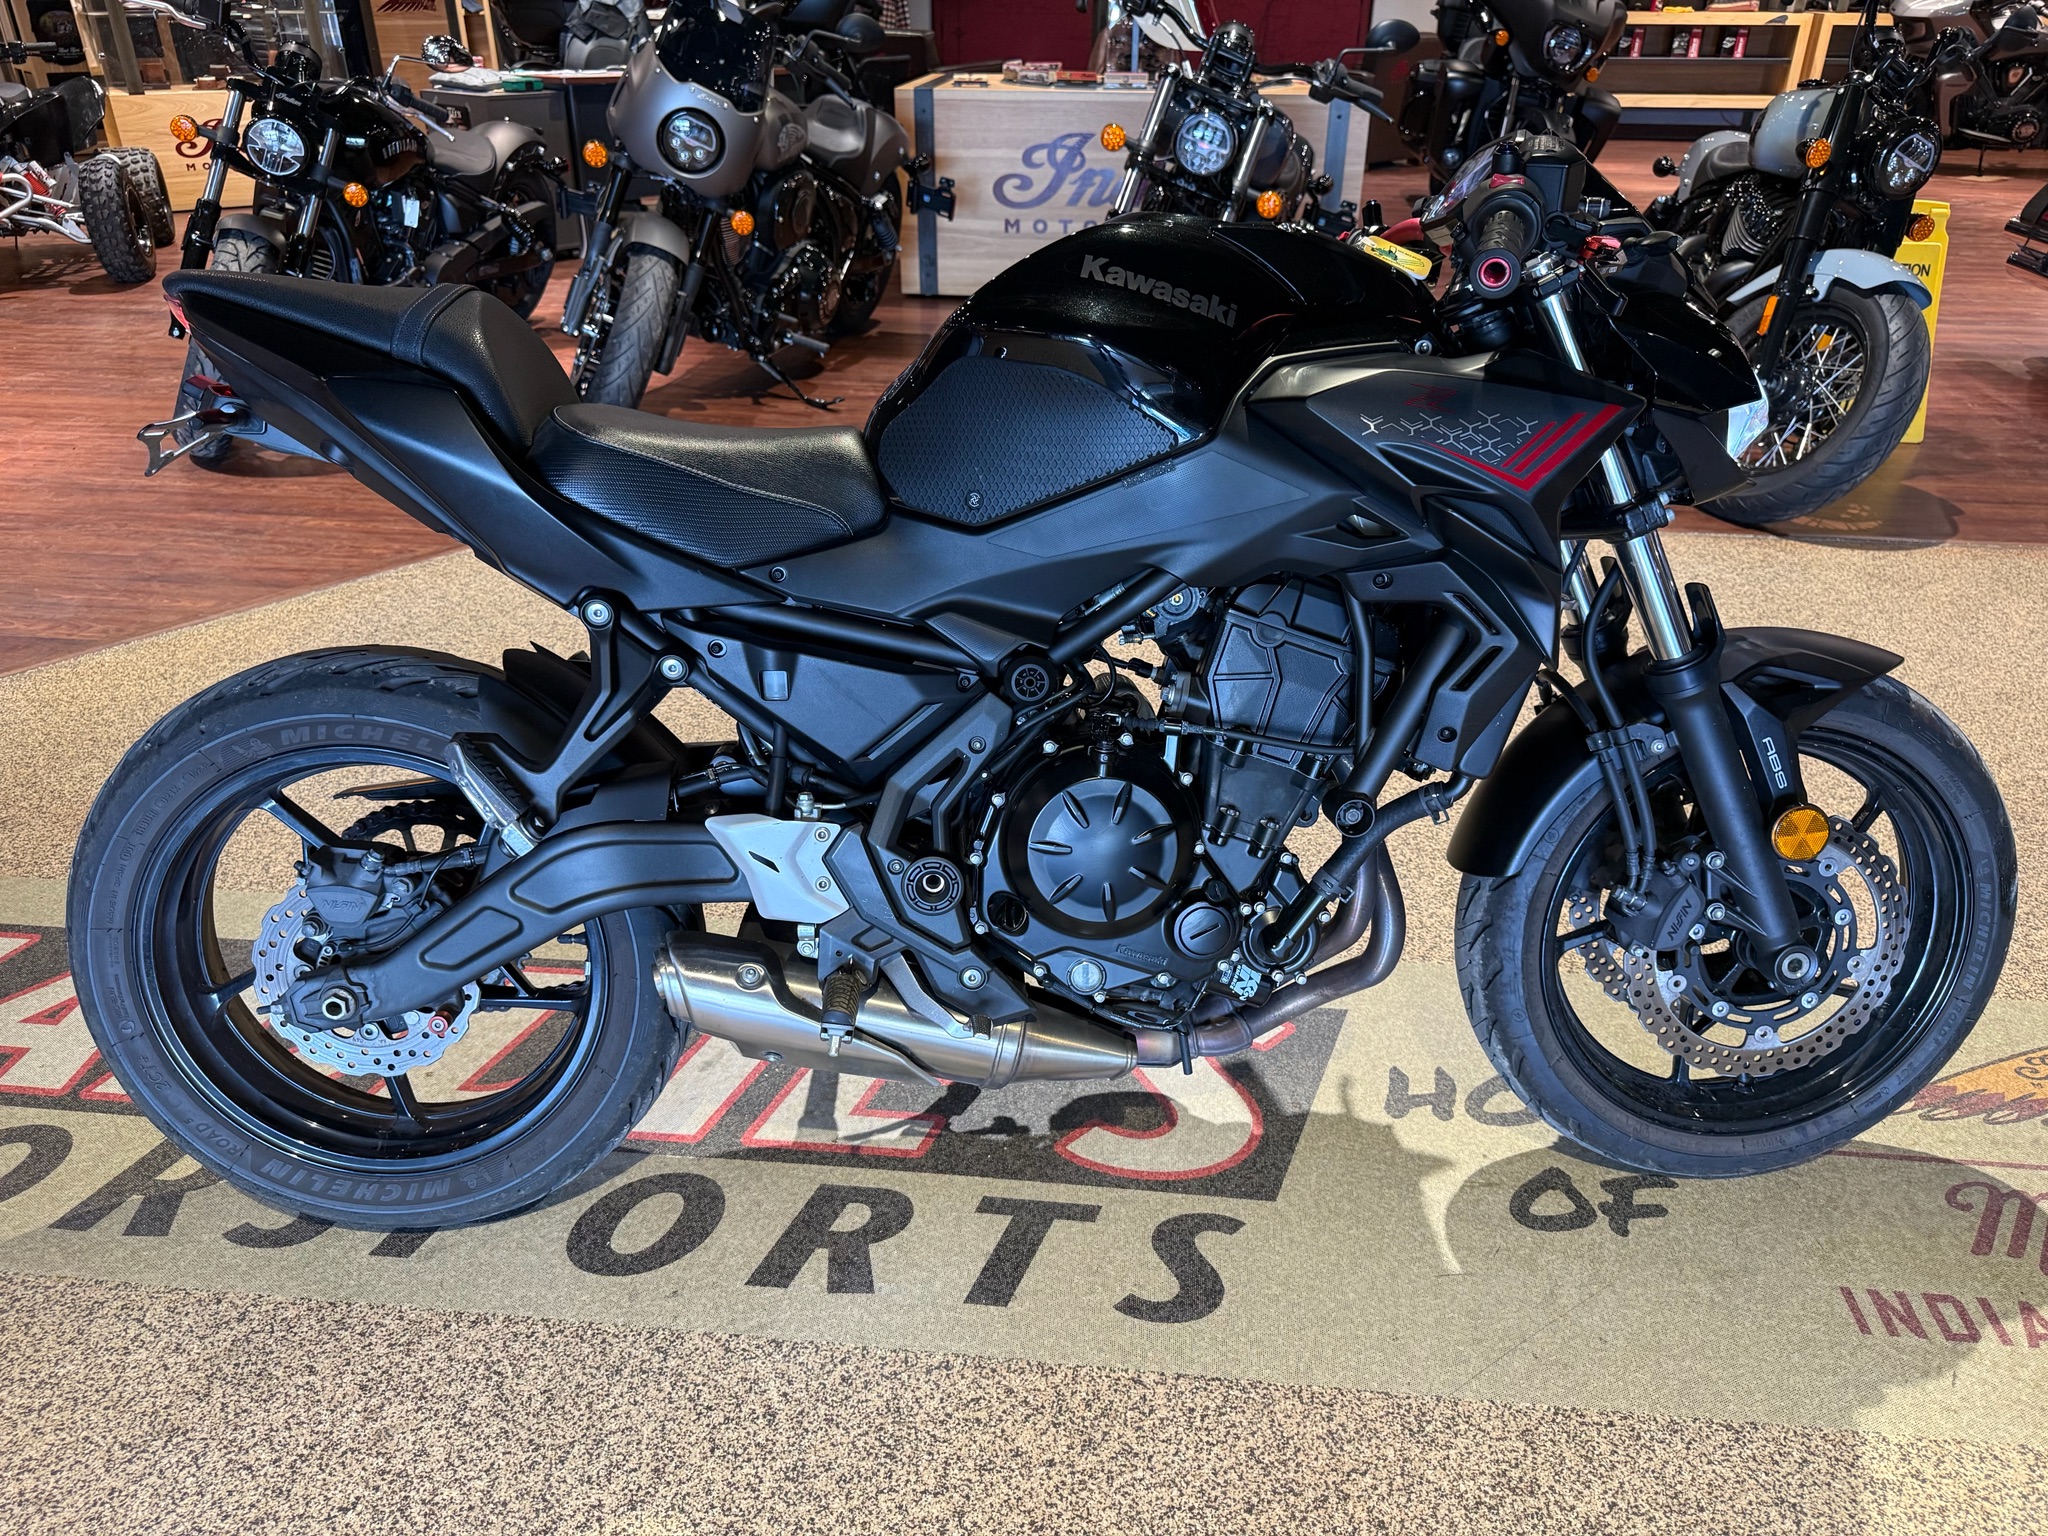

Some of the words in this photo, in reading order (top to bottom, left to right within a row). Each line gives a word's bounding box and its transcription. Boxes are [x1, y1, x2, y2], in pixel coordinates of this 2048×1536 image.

[1080, 254, 1238, 328] Kawasaki
[1762, 736, 1788, 790] ABS
[1115, 943, 1168, 966] Kawasaki
[1962, 881, 1993, 991] MICHELIN
[195, 1123, 241, 1157] ROAD
[261, 1158, 451, 1200] MICHELIN
[1509, 1167, 1678, 1237] OF
